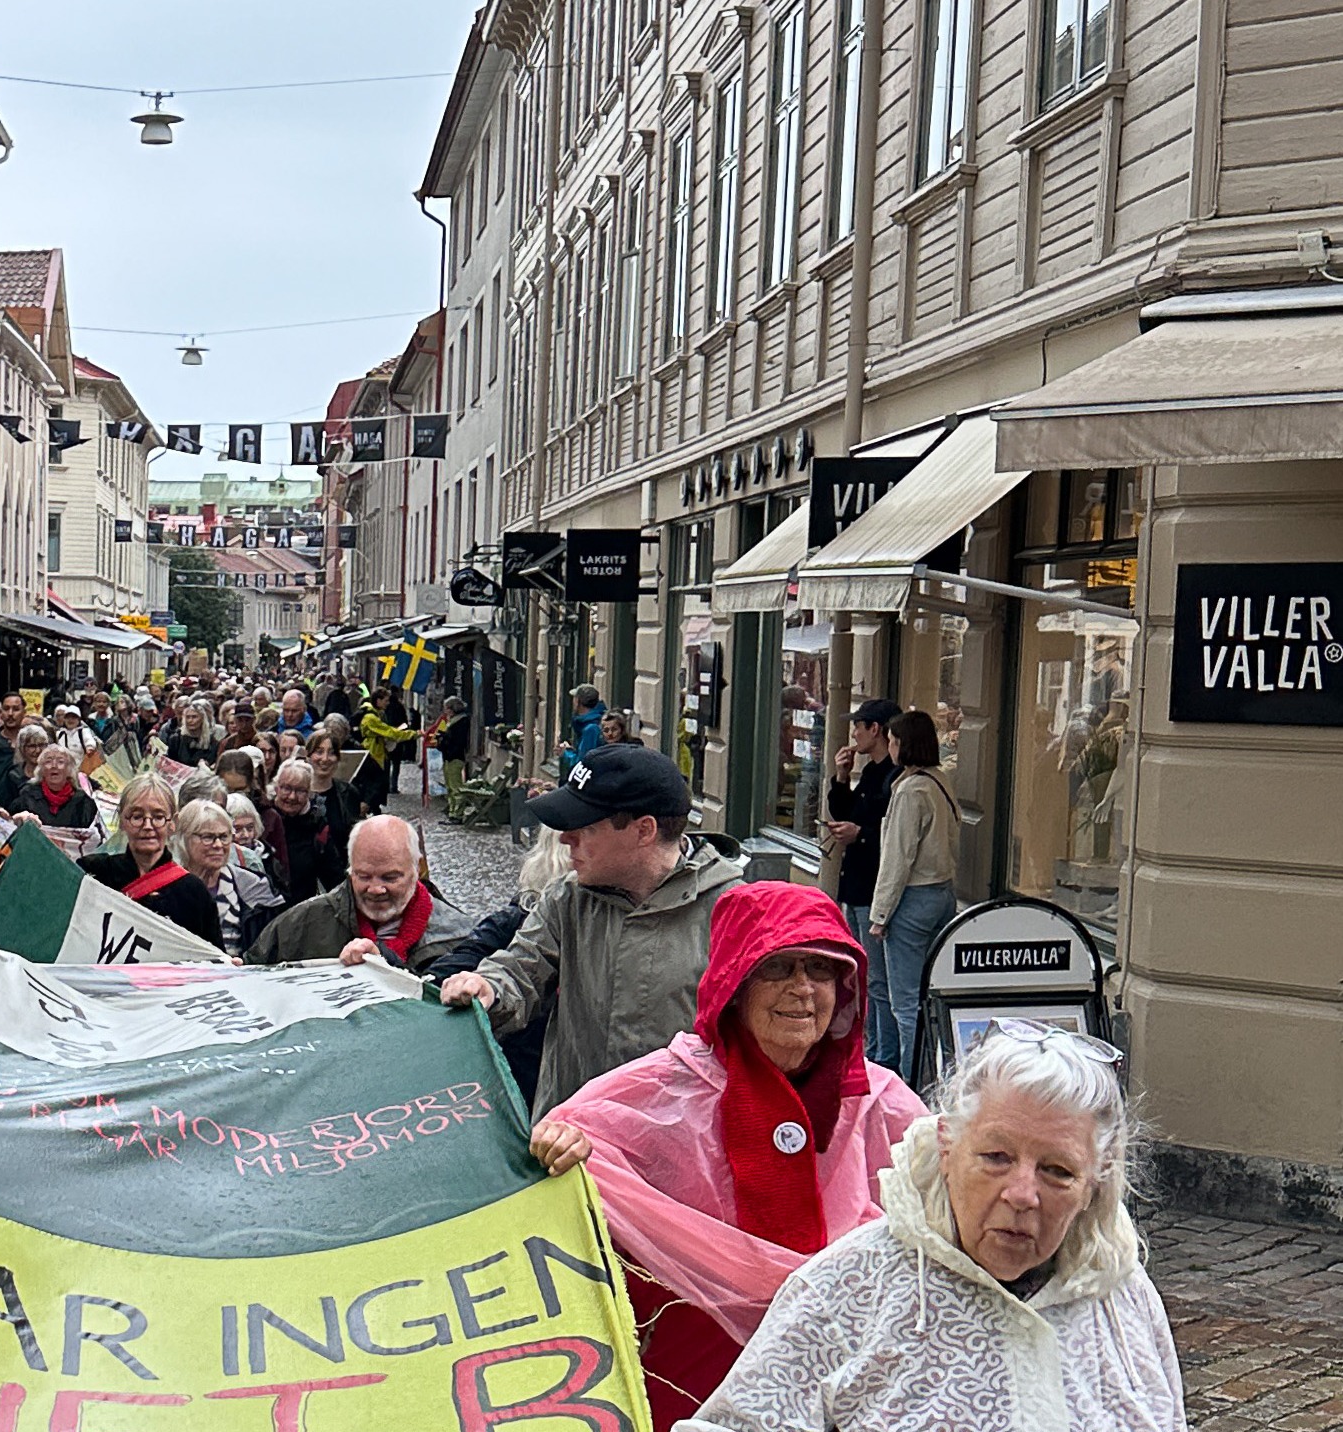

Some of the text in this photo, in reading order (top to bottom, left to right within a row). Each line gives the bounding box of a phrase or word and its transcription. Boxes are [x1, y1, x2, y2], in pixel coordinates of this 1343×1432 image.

[181, 526, 291, 549] HAGA
[579, 555, 627, 565] LAKRITS
[583, 566, 622, 576] ROTEN
[1201, 595, 1334, 641] VILLER
[1203, 645, 1323, 691] VALLA
[961, 946, 1059, 968] VILLERVALLA
[219, 1234, 615, 1376] INGEN
